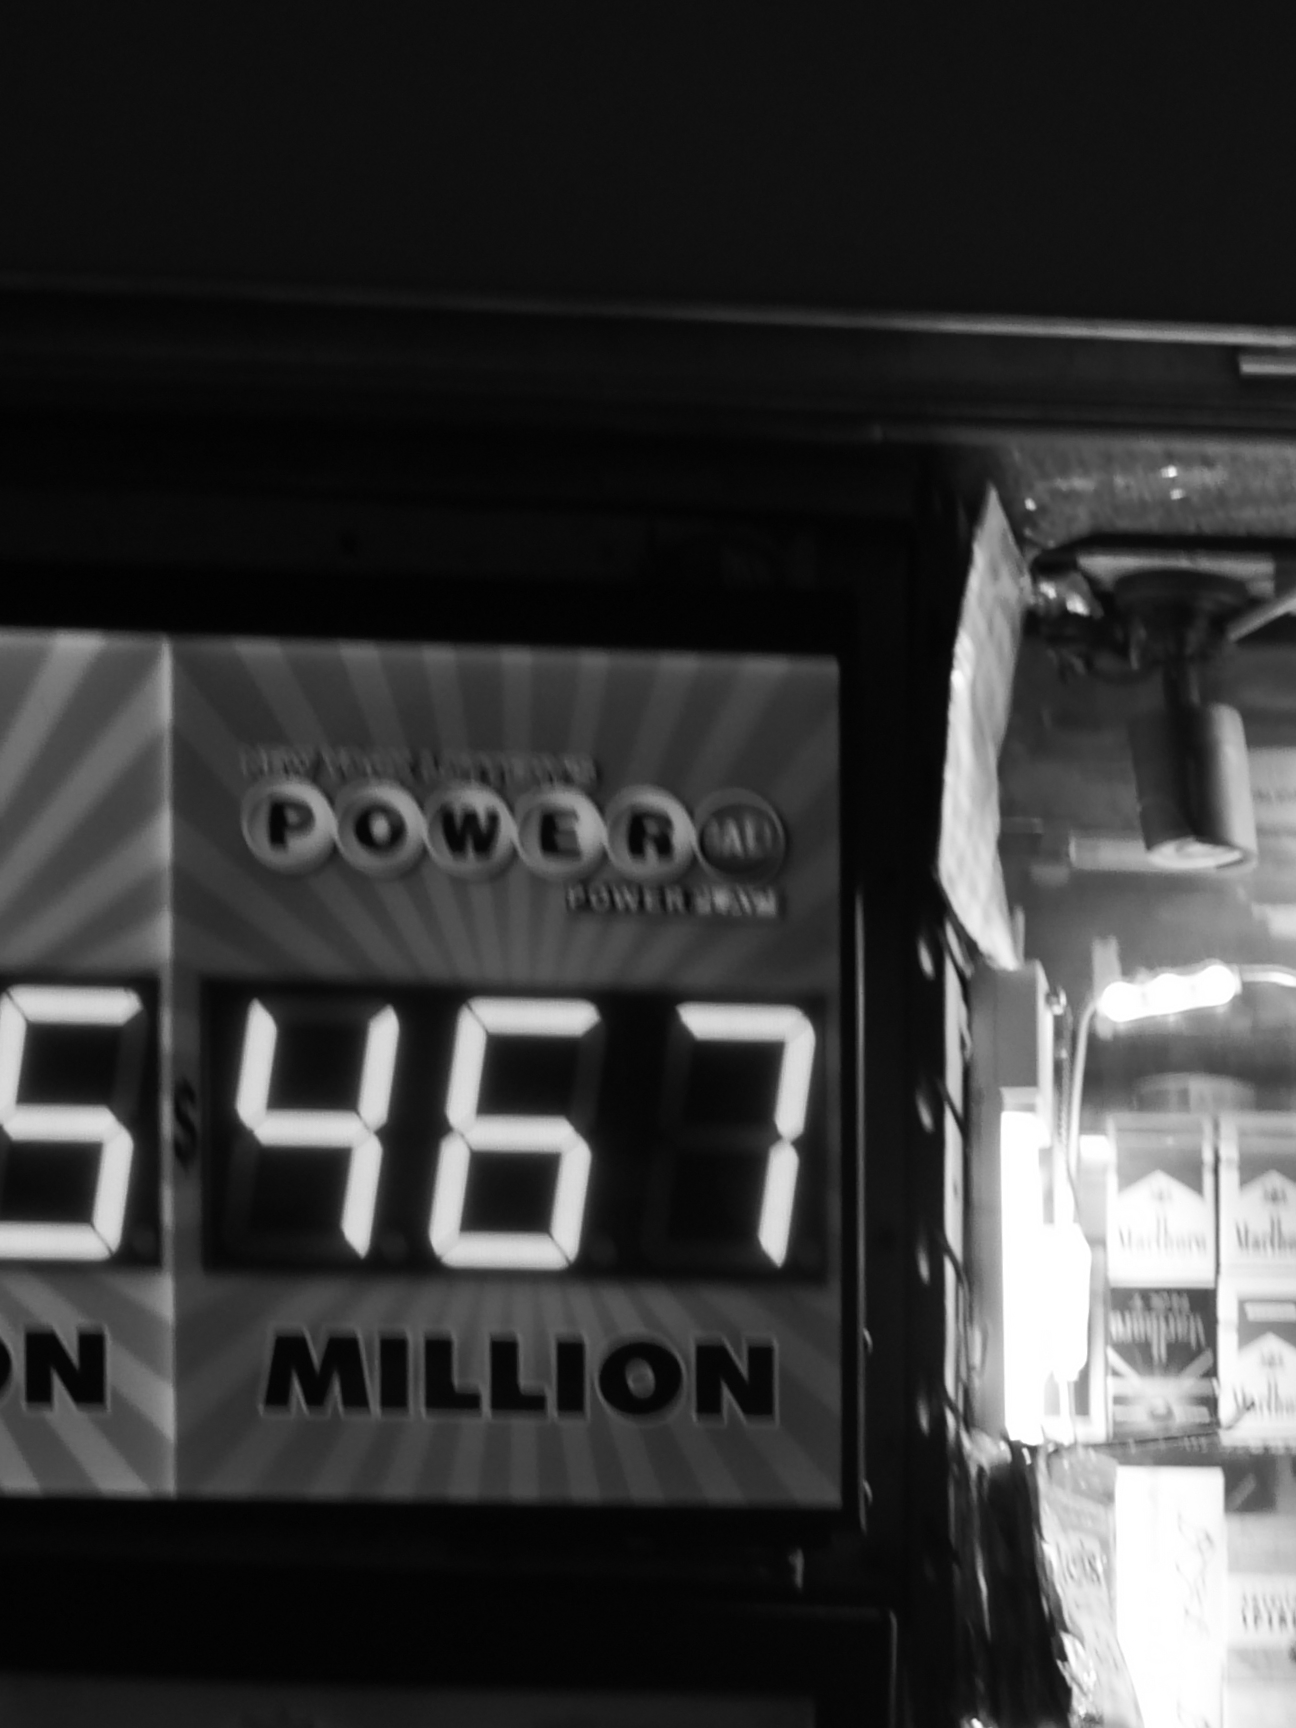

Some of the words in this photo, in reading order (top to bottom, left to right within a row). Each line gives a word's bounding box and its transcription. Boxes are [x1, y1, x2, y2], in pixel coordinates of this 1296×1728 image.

[236, 997, 816, 1271] 467
[0, 1331, 108, 1405] N
[264, 1332, 779, 1420] MILLION
